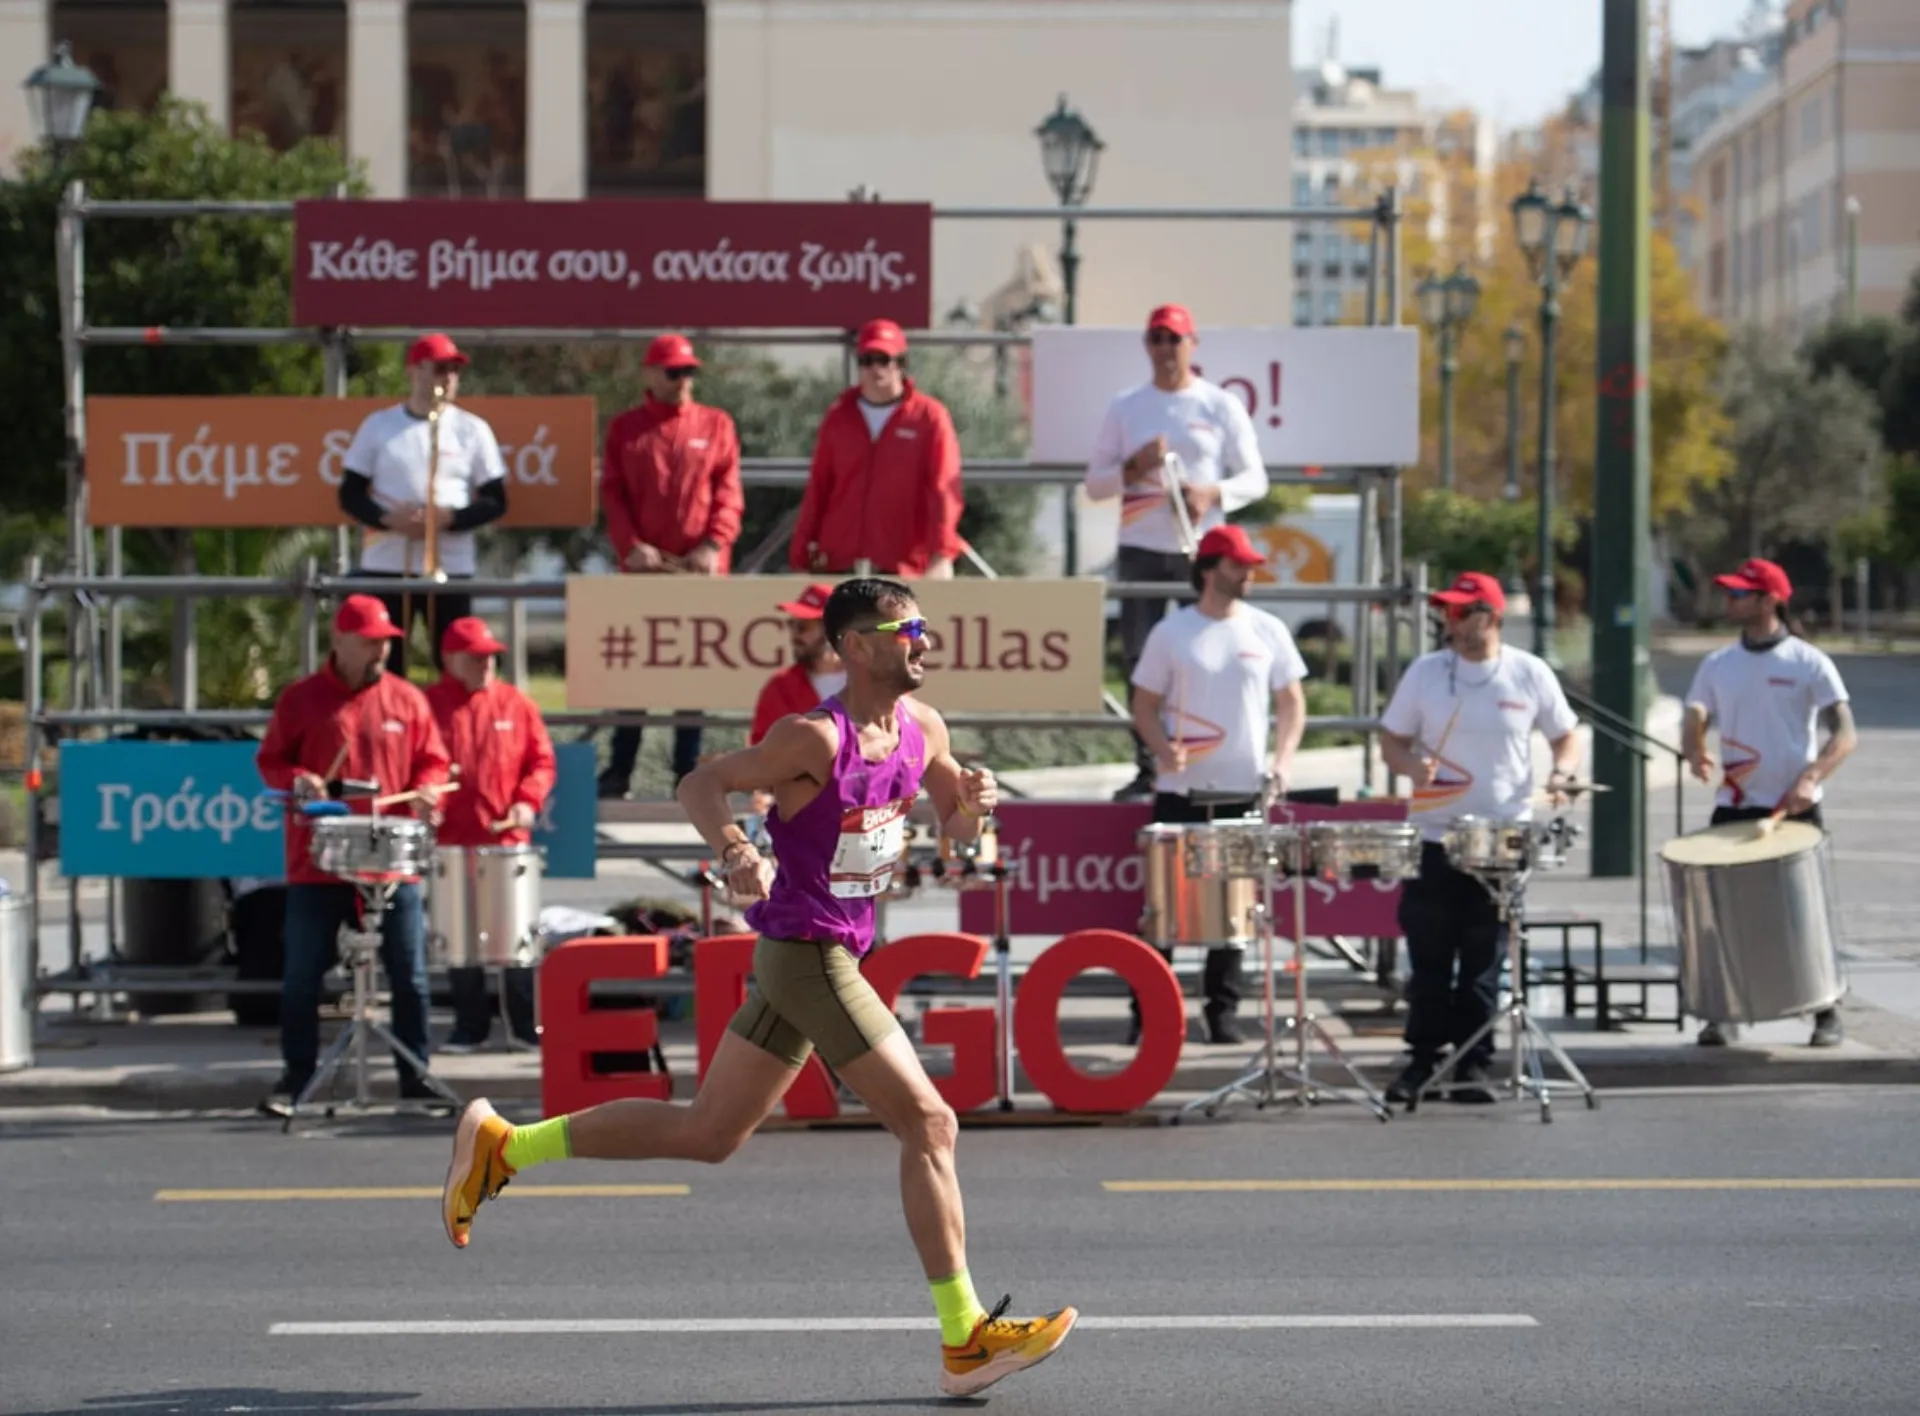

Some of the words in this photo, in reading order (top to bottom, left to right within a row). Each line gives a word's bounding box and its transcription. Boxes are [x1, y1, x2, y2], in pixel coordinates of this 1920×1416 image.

[307, 236, 419, 281] Κάθε
[427, 236, 540, 291] βήμα
[546, 247, 642, 290] σου,
[652, 236, 790, 283] ανάσα
[797, 237, 917, 292] ζωής.
[120, 424, 302, 500] Πάμε
[95, 775, 283, 845] Γράφε
